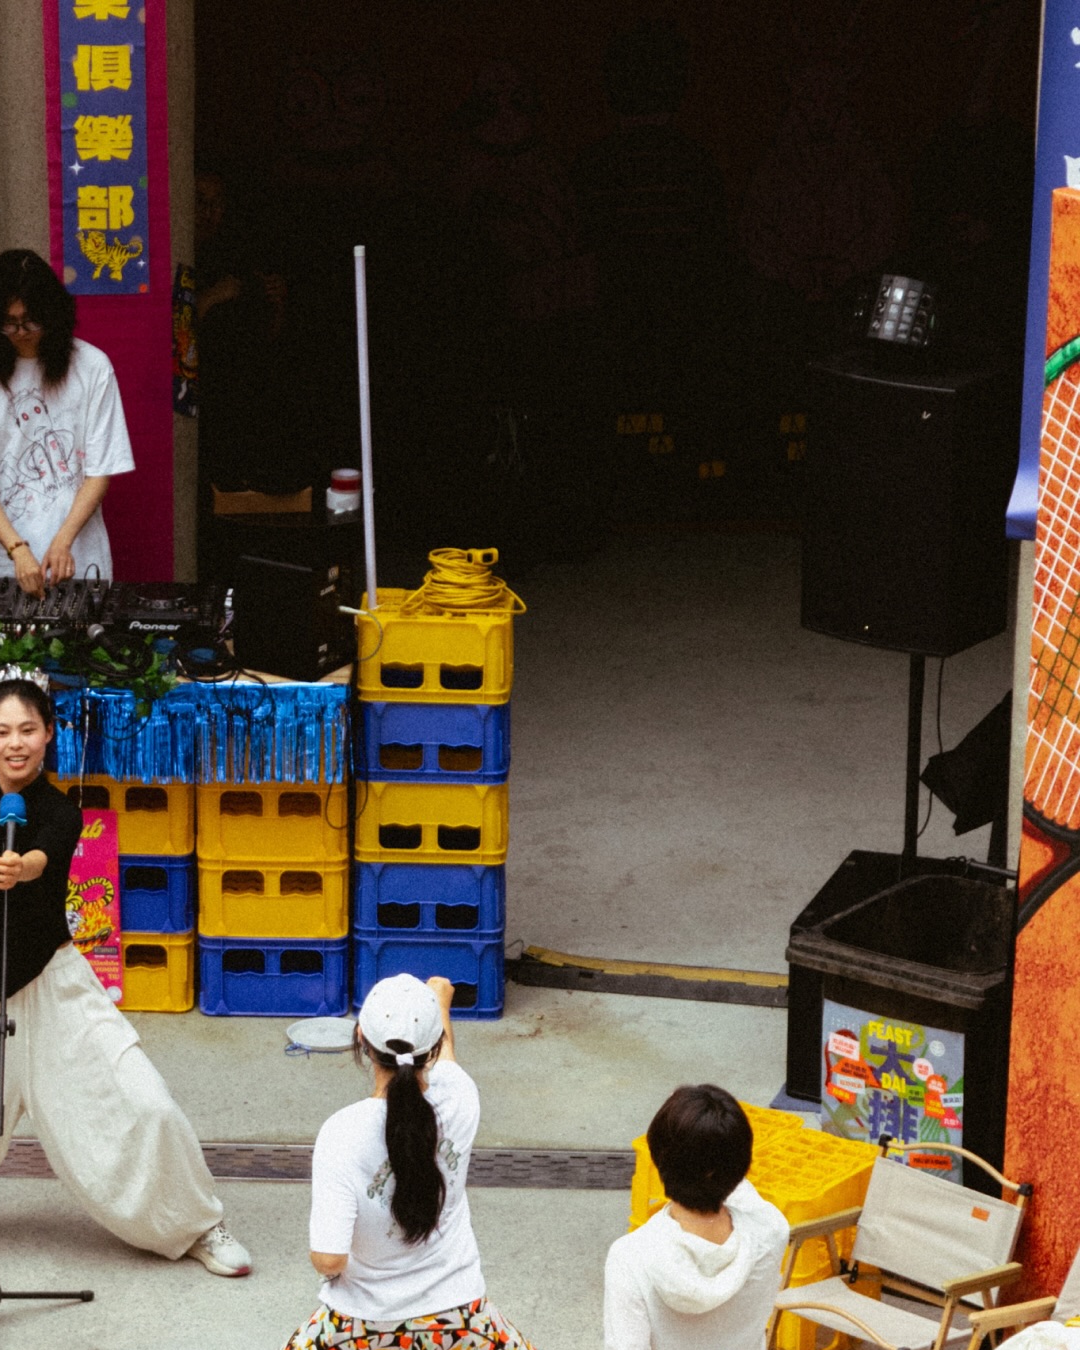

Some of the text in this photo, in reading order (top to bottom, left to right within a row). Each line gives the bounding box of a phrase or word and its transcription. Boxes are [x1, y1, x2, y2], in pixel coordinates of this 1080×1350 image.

[129, 621, 180, 630] Pioneer
[869, 1020, 912, 1046] FEAST
[871, 1039, 918, 1086] 大
[881, 1072, 907, 1094] DAI
